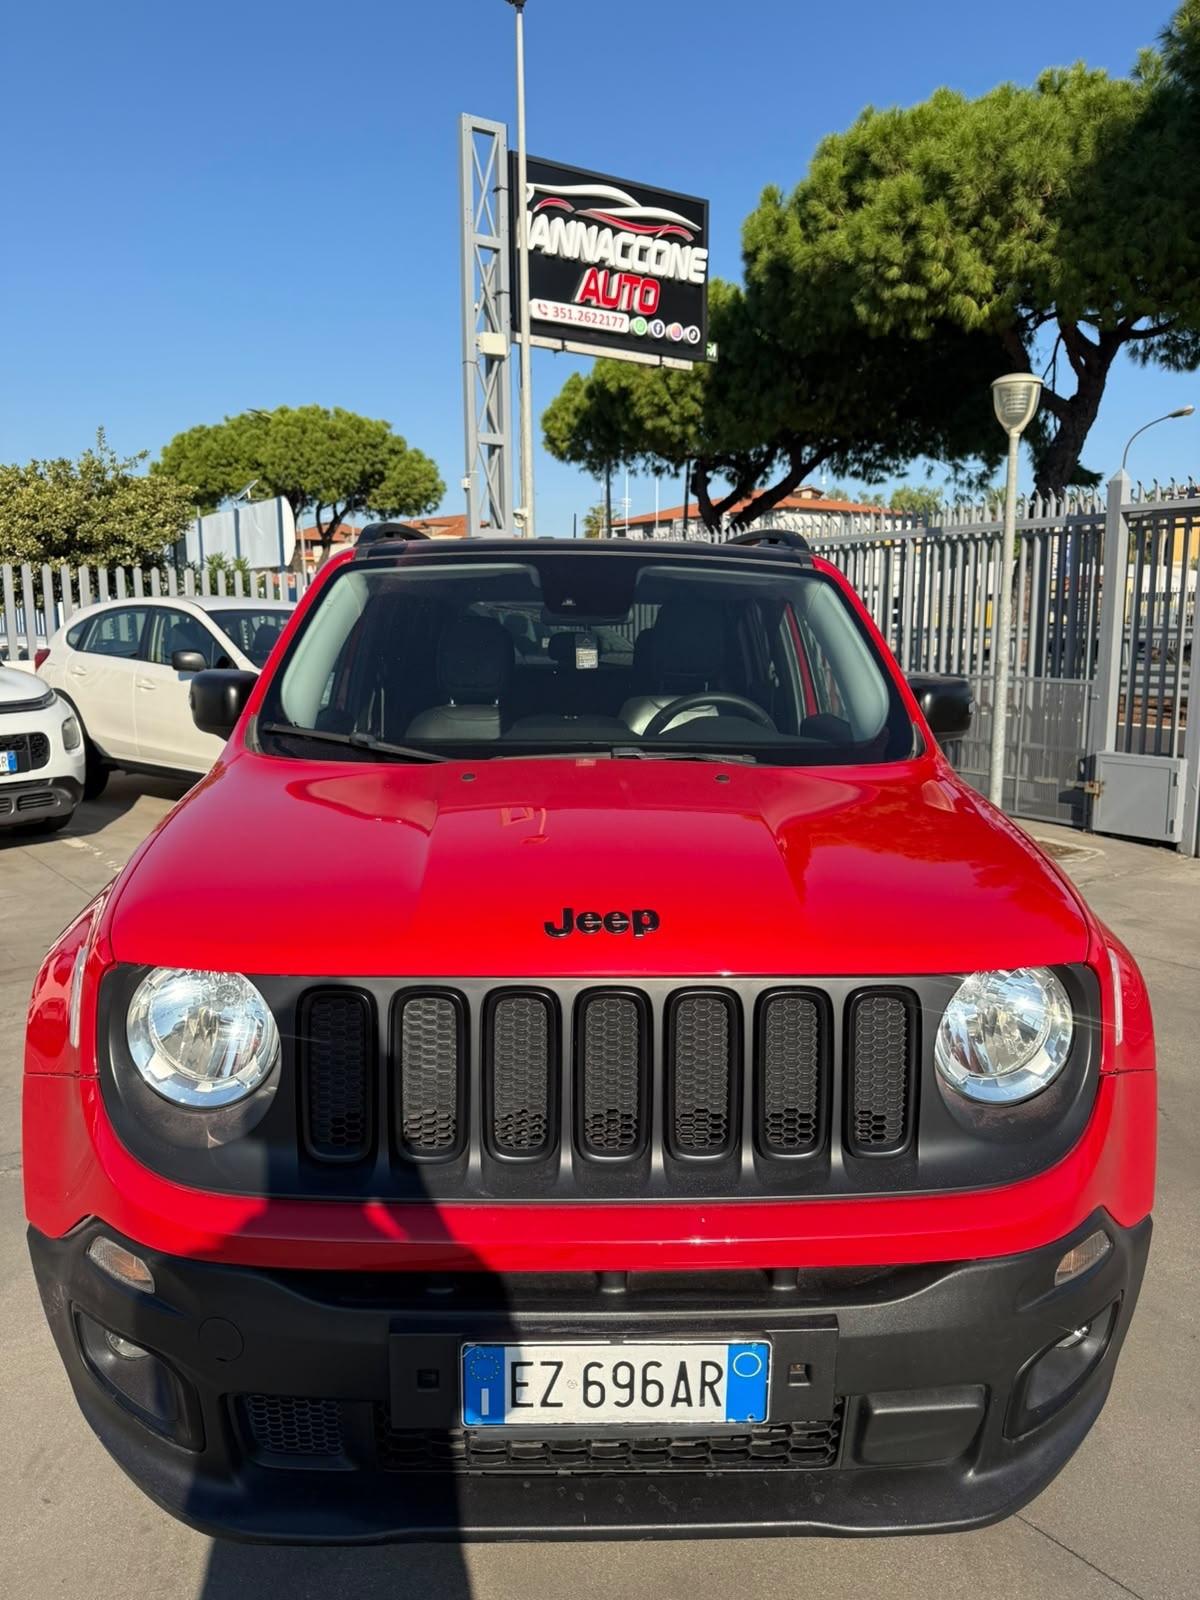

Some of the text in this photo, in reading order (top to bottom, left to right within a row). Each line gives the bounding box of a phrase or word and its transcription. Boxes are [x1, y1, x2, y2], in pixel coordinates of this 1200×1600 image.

[576, 267, 661, 316] AUTO
[552, 305, 625, 330] 351.2622177
[543, 907, 661, 938] Jeep
[510, 1360, 724, 1409] EZ 696AR
